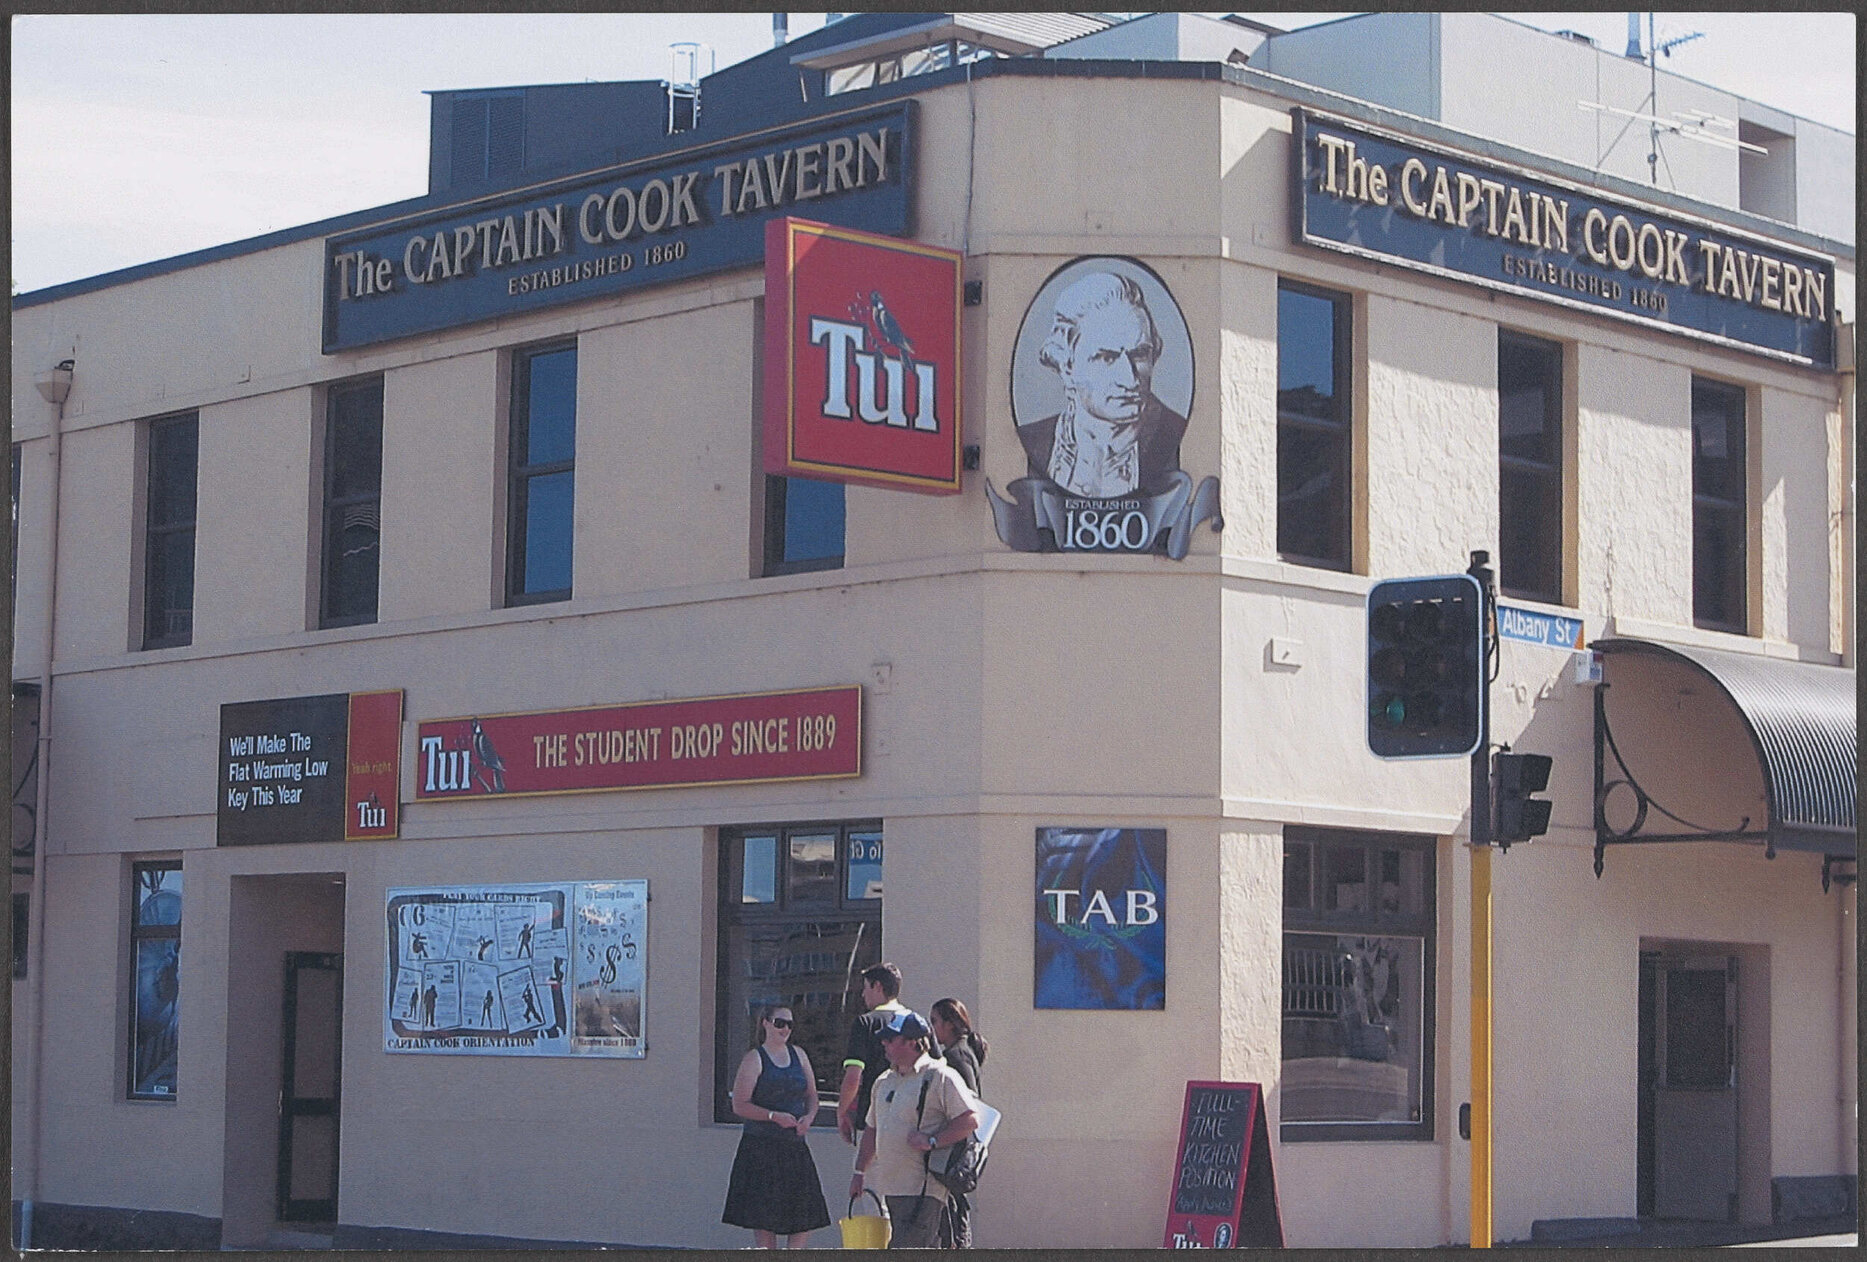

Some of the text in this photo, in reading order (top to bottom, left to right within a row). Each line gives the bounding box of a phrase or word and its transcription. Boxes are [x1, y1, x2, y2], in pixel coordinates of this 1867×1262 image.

[335, 127, 889, 300] The CAPTAIN COOK TAVERN
[1316, 132, 1828, 322] The CAPTAIN COOK TAVERN
[508, 241, 685, 296] ESTABLISHED 1860
[1503, 253, 1668, 313] ESTABLISHED 1860
[811, 316, 938, 433] Tui
[1065, 499, 1140, 510] ESTABLISHED
[1063, 510, 1149, 549] 1860
[1502, 607, 1571, 645] Albany St
[230, 732, 311, 757] We'll Make The
[533, 714, 836, 769] THE STUDENT DROP SINCE 1889
[229, 757, 328, 782] Flat Warming Low
[421, 735, 471, 792] Tui
[228, 784, 302, 811] Key This Year
[357, 801, 386, 828] Tui
[1043, 889, 1159, 925] TAB
[387, 1036, 536, 1049] CAPTAIN COOK ORIENTATION
[1190, 1116, 1229, 1140] TIME
[1182, 1142, 1241, 1167] KITCHEN
[1178, 1166, 1236, 1190] POSITION
